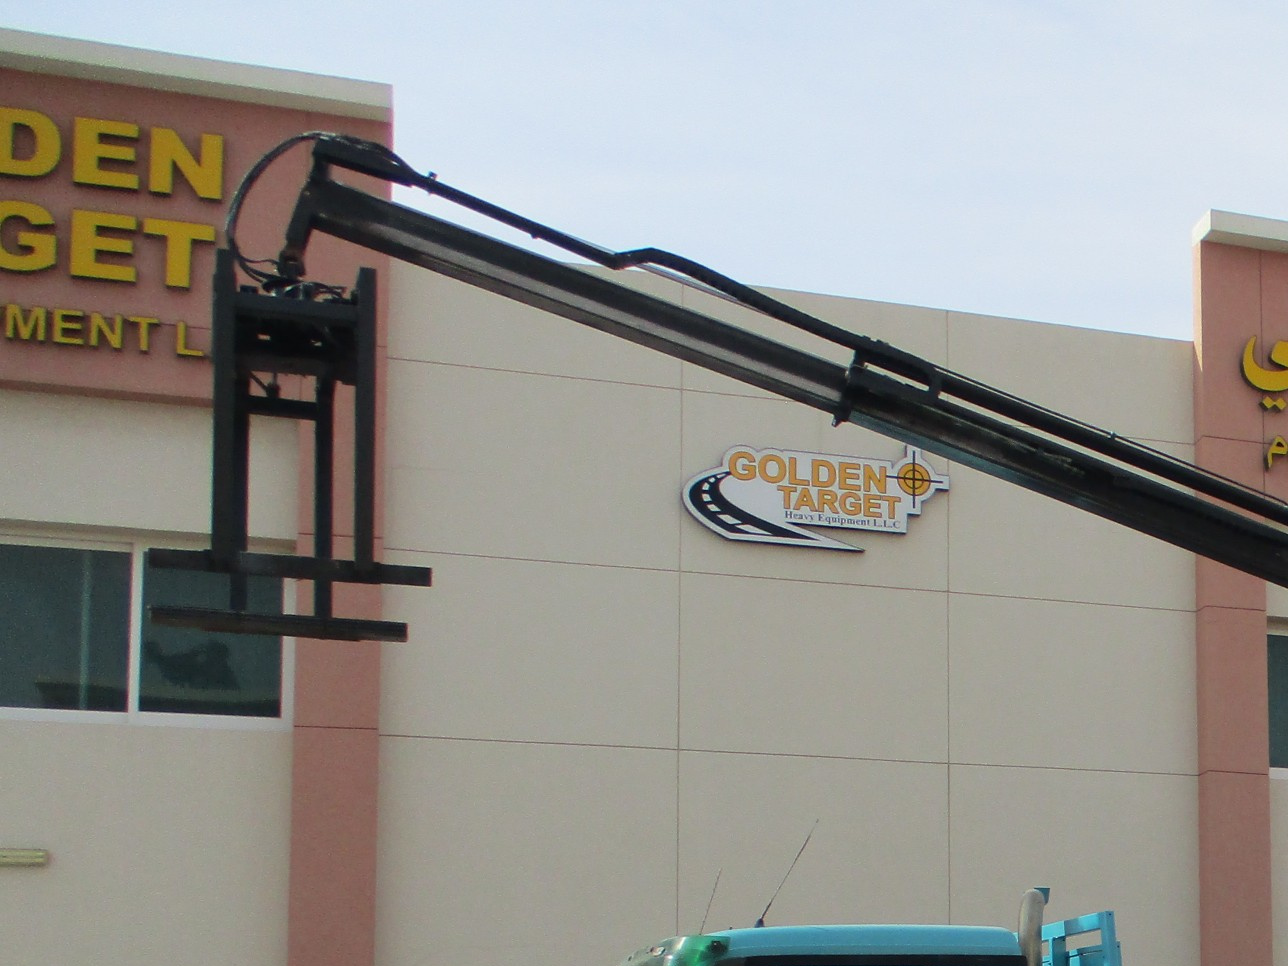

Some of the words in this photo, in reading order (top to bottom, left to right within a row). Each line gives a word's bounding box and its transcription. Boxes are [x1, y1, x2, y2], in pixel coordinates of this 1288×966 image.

[728, 451, 887, 494] GOLDEN
[777, 485, 902, 520] TARGET
[785, 510, 814, 522] Heavy
[818, 513, 870, 526] Equipment
